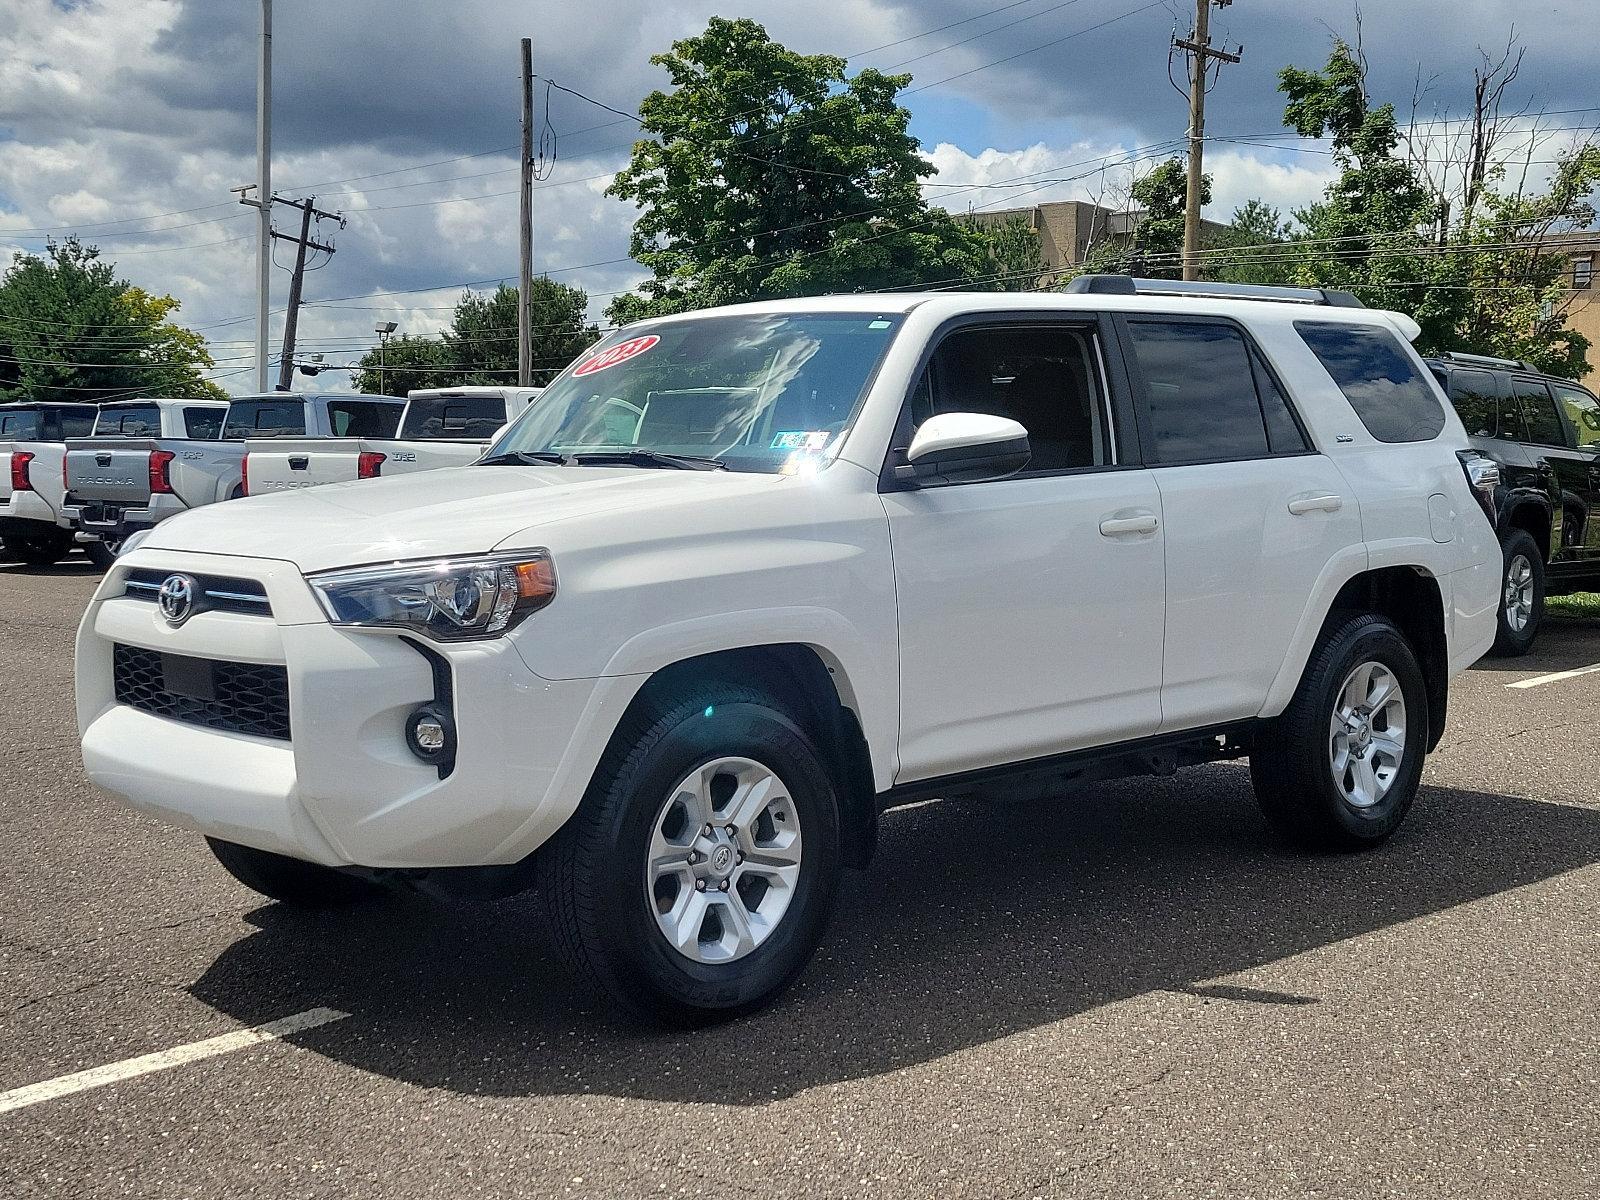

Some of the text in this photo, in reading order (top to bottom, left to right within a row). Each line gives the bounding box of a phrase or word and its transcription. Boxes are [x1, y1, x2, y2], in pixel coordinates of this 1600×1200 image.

[580, 337, 651, 374] 2023
[77, 476, 136, 486] TACOMA
[262, 480, 336, 490] TACOM
